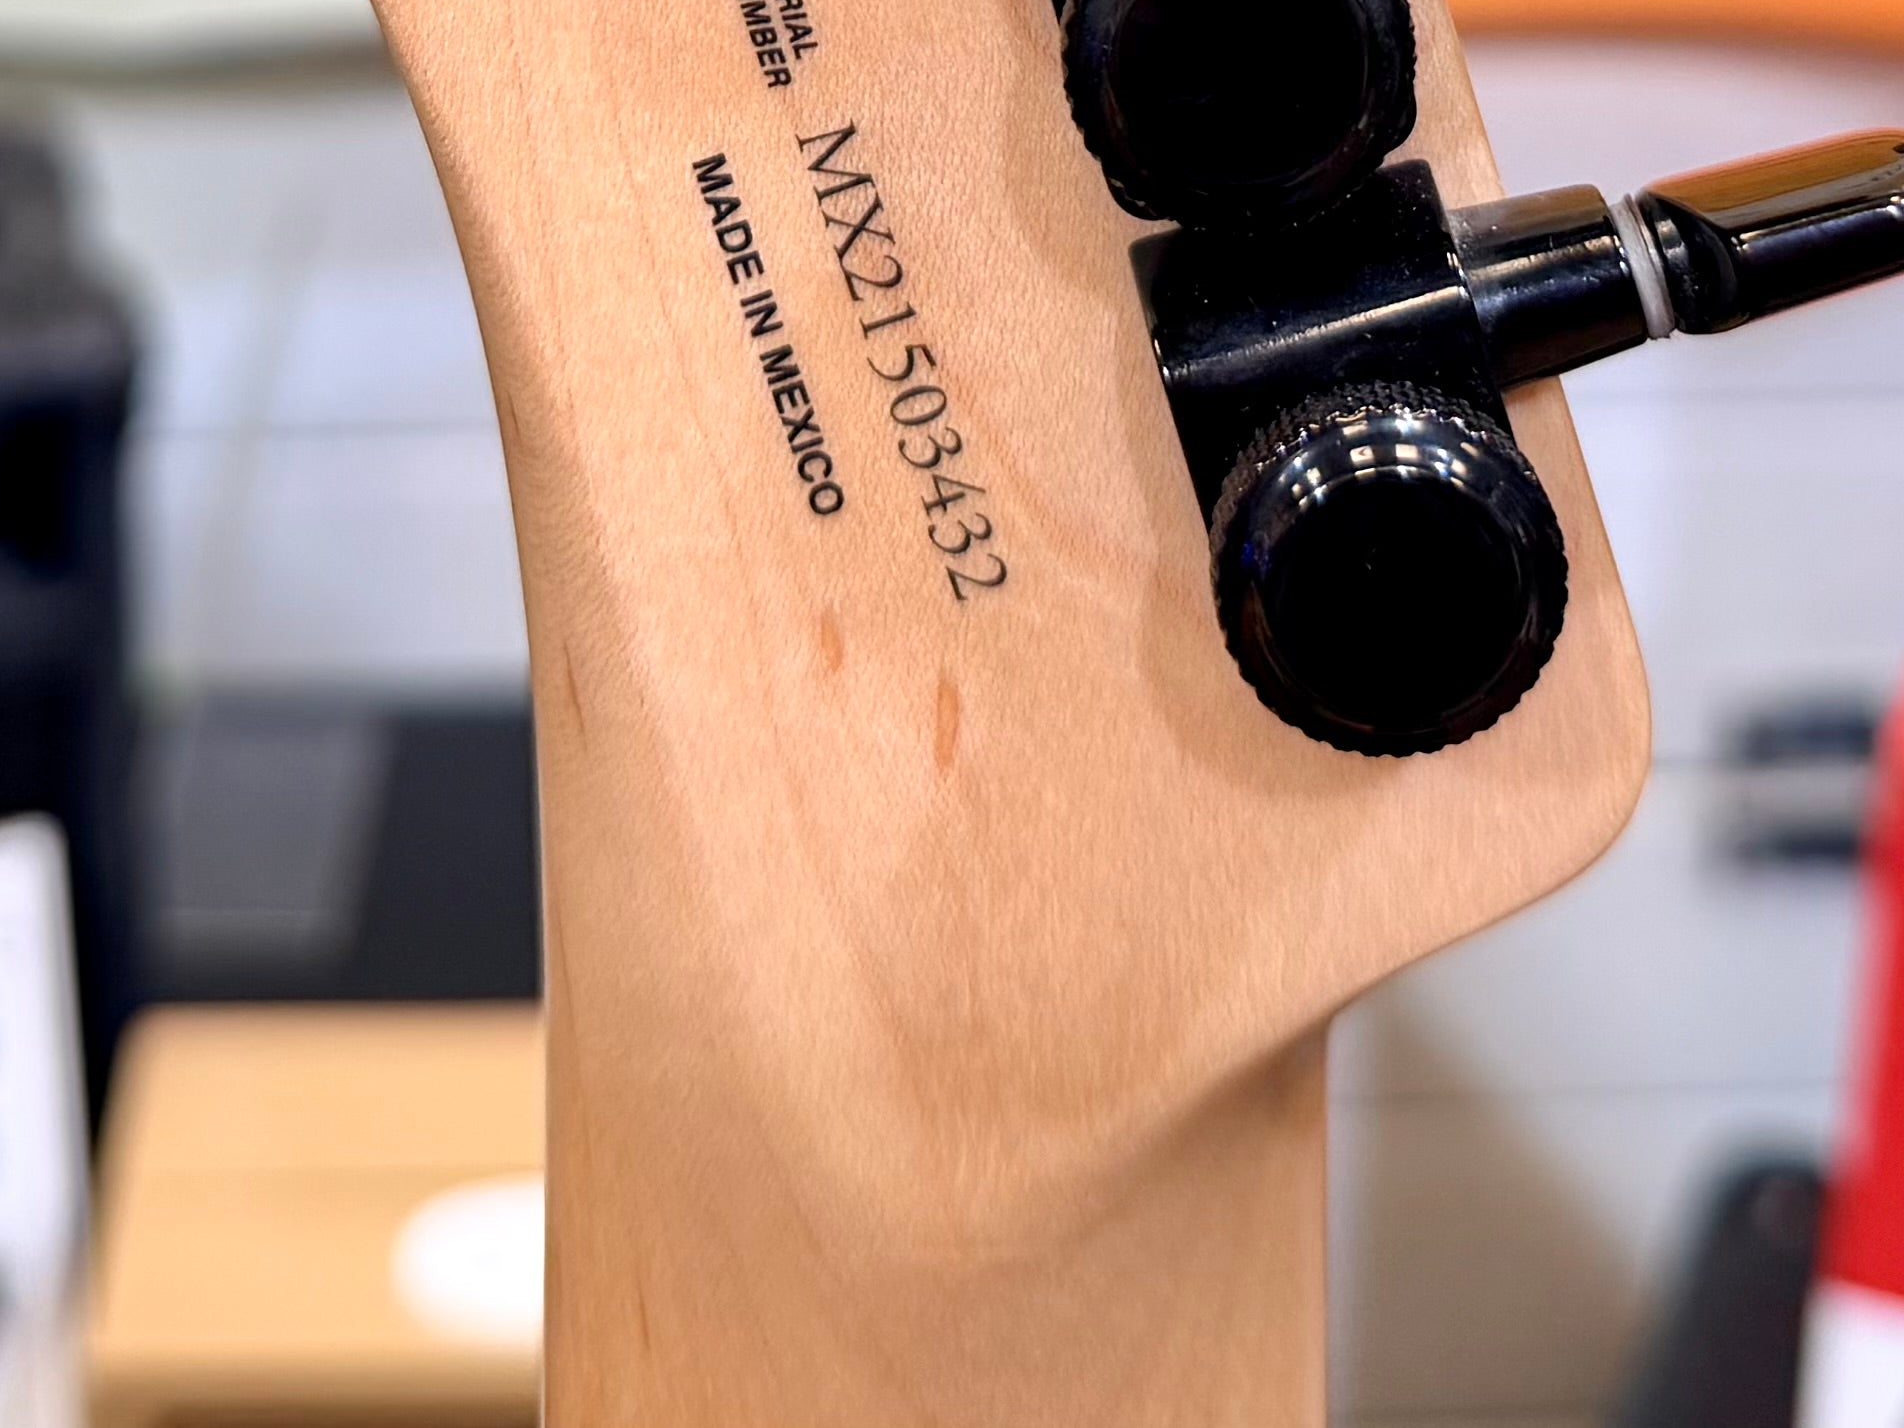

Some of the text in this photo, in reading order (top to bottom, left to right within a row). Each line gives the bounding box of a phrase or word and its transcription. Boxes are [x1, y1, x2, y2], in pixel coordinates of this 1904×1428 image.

[691, 151, 847, 519] MADE IN MEXICO
[794, 117, 1009, 604] MX21503432
